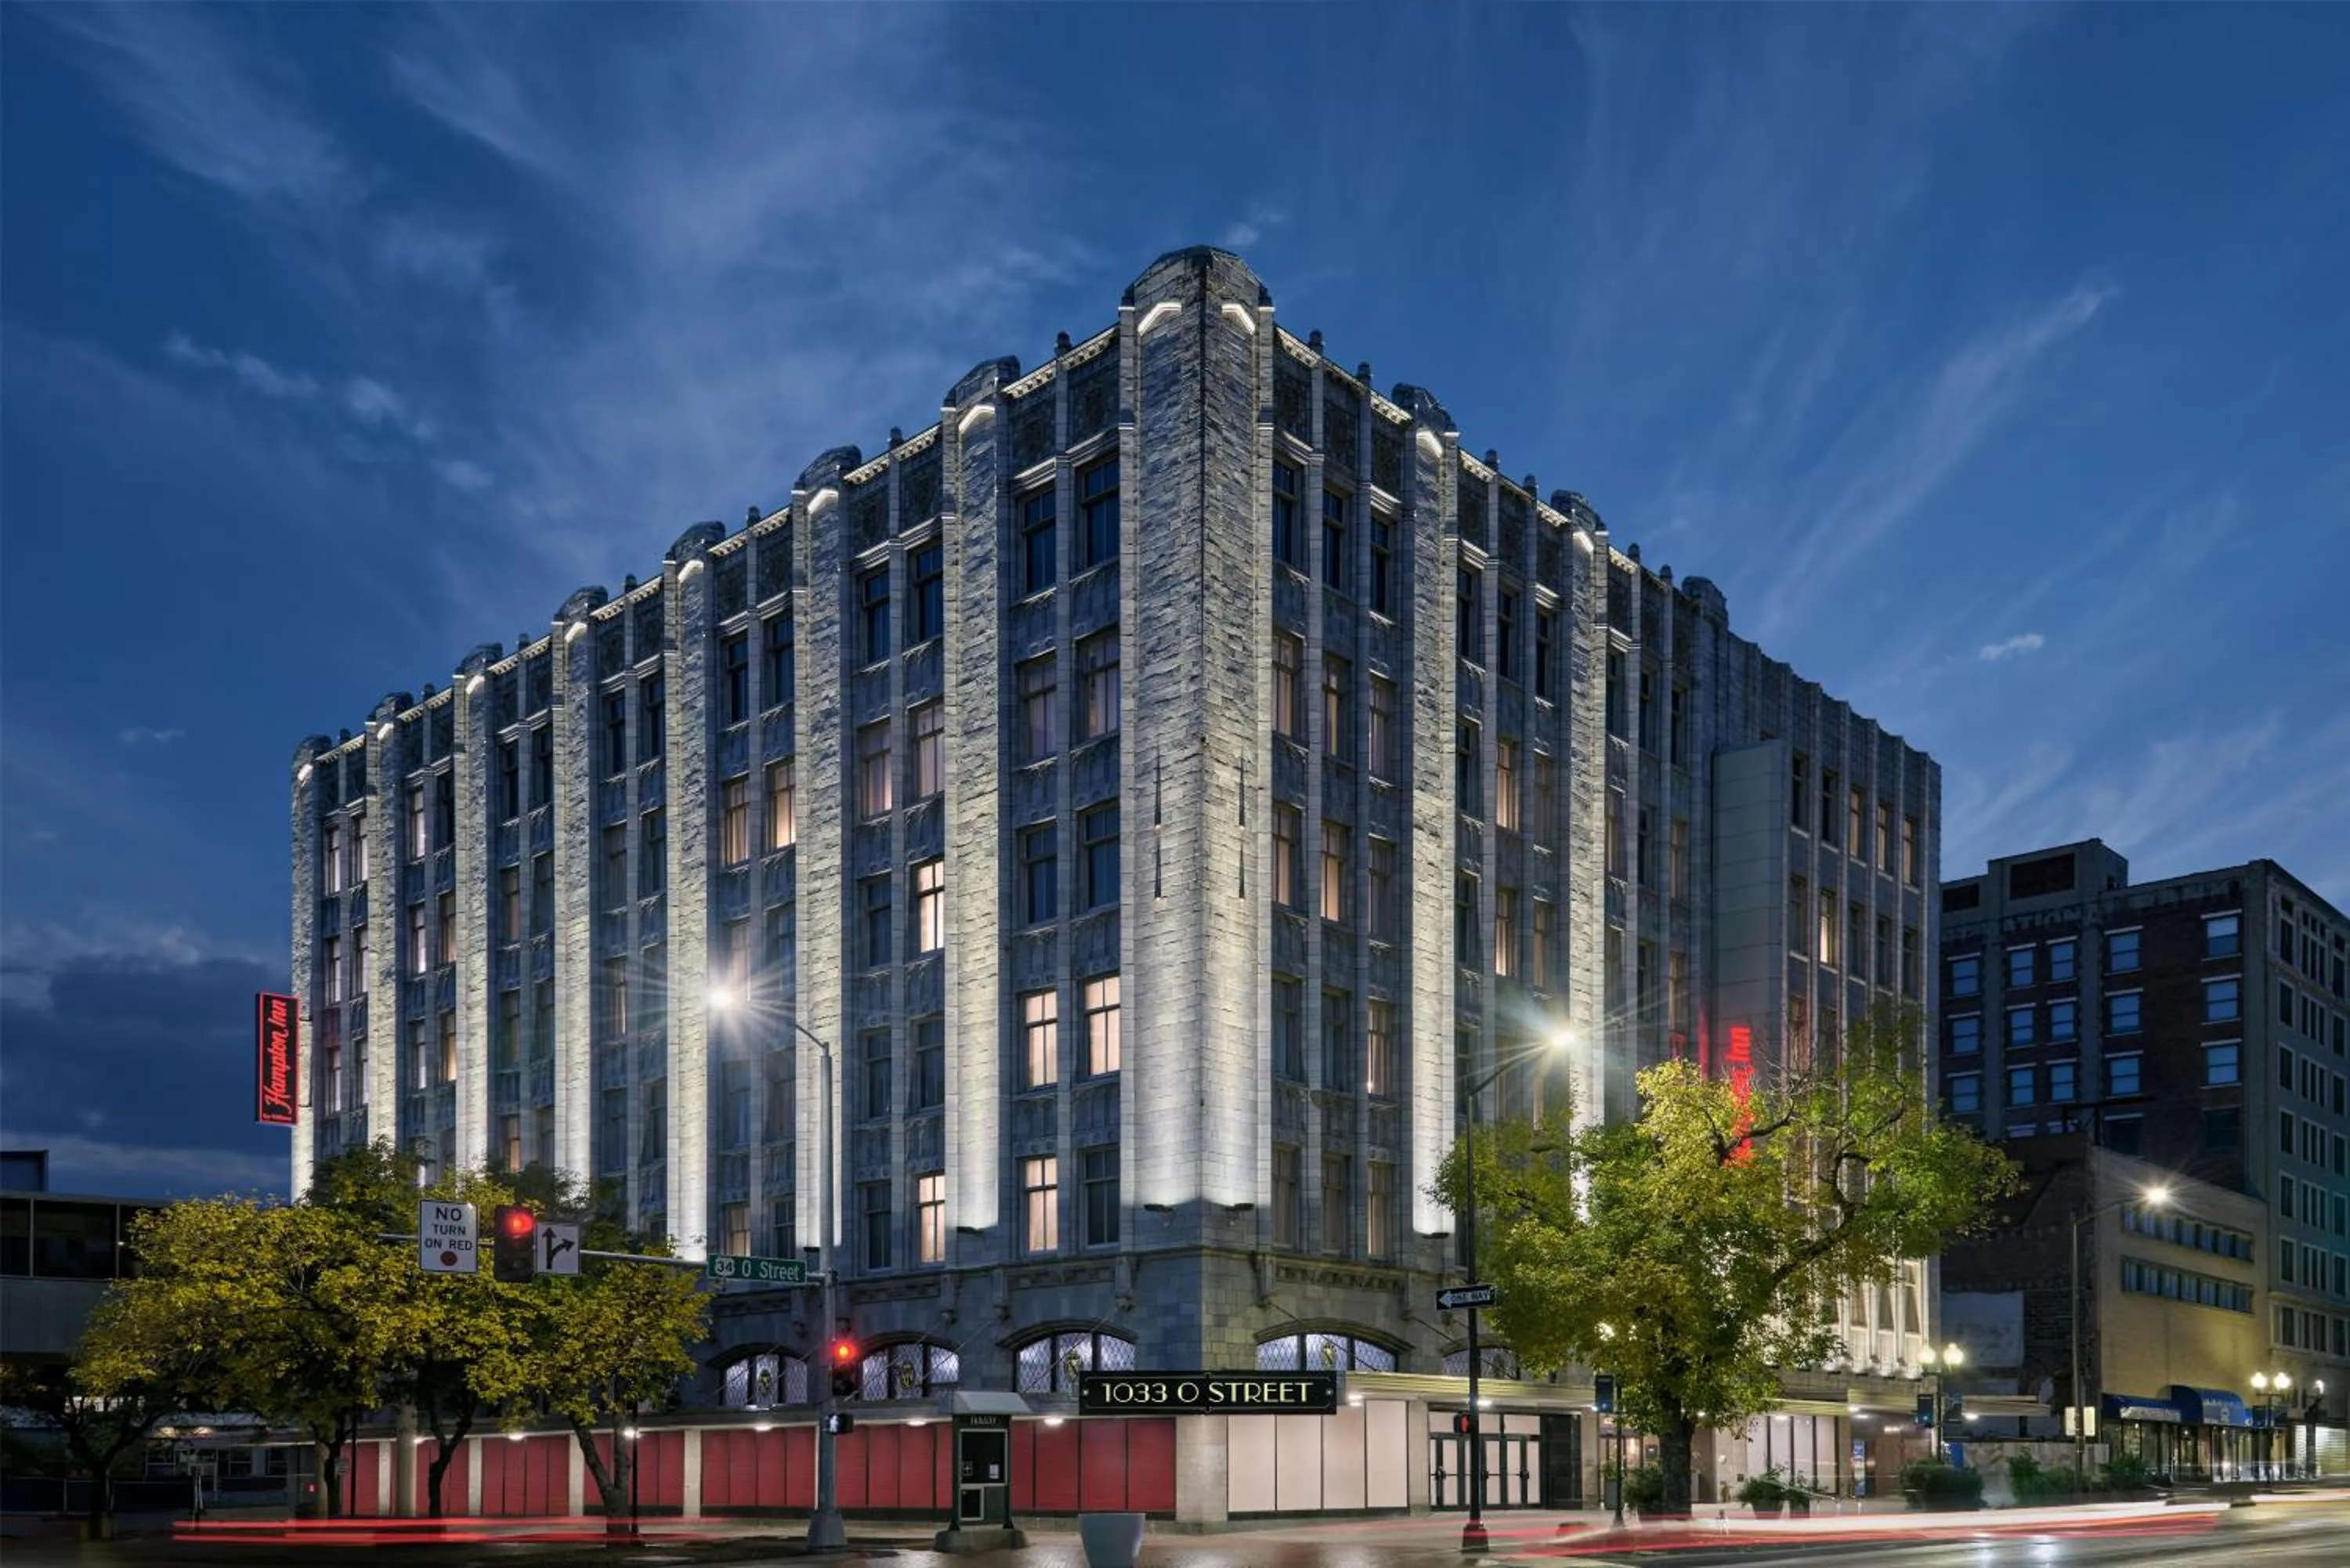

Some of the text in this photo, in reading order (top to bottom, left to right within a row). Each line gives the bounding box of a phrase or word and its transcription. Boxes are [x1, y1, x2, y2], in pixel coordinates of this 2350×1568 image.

[267, 999, 287, 1028] Inn
[263, 1029, 292, 1114] Hampton
[436, 1207, 462, 1222] NO
[433, 1224, 466, 1236] TURN
[425, 1238, 472, 1251] ON RED
[717, 1259, 800, 1281] 34 O Street
[1101, 1382, 1314, 1404] 1033 O STREET
